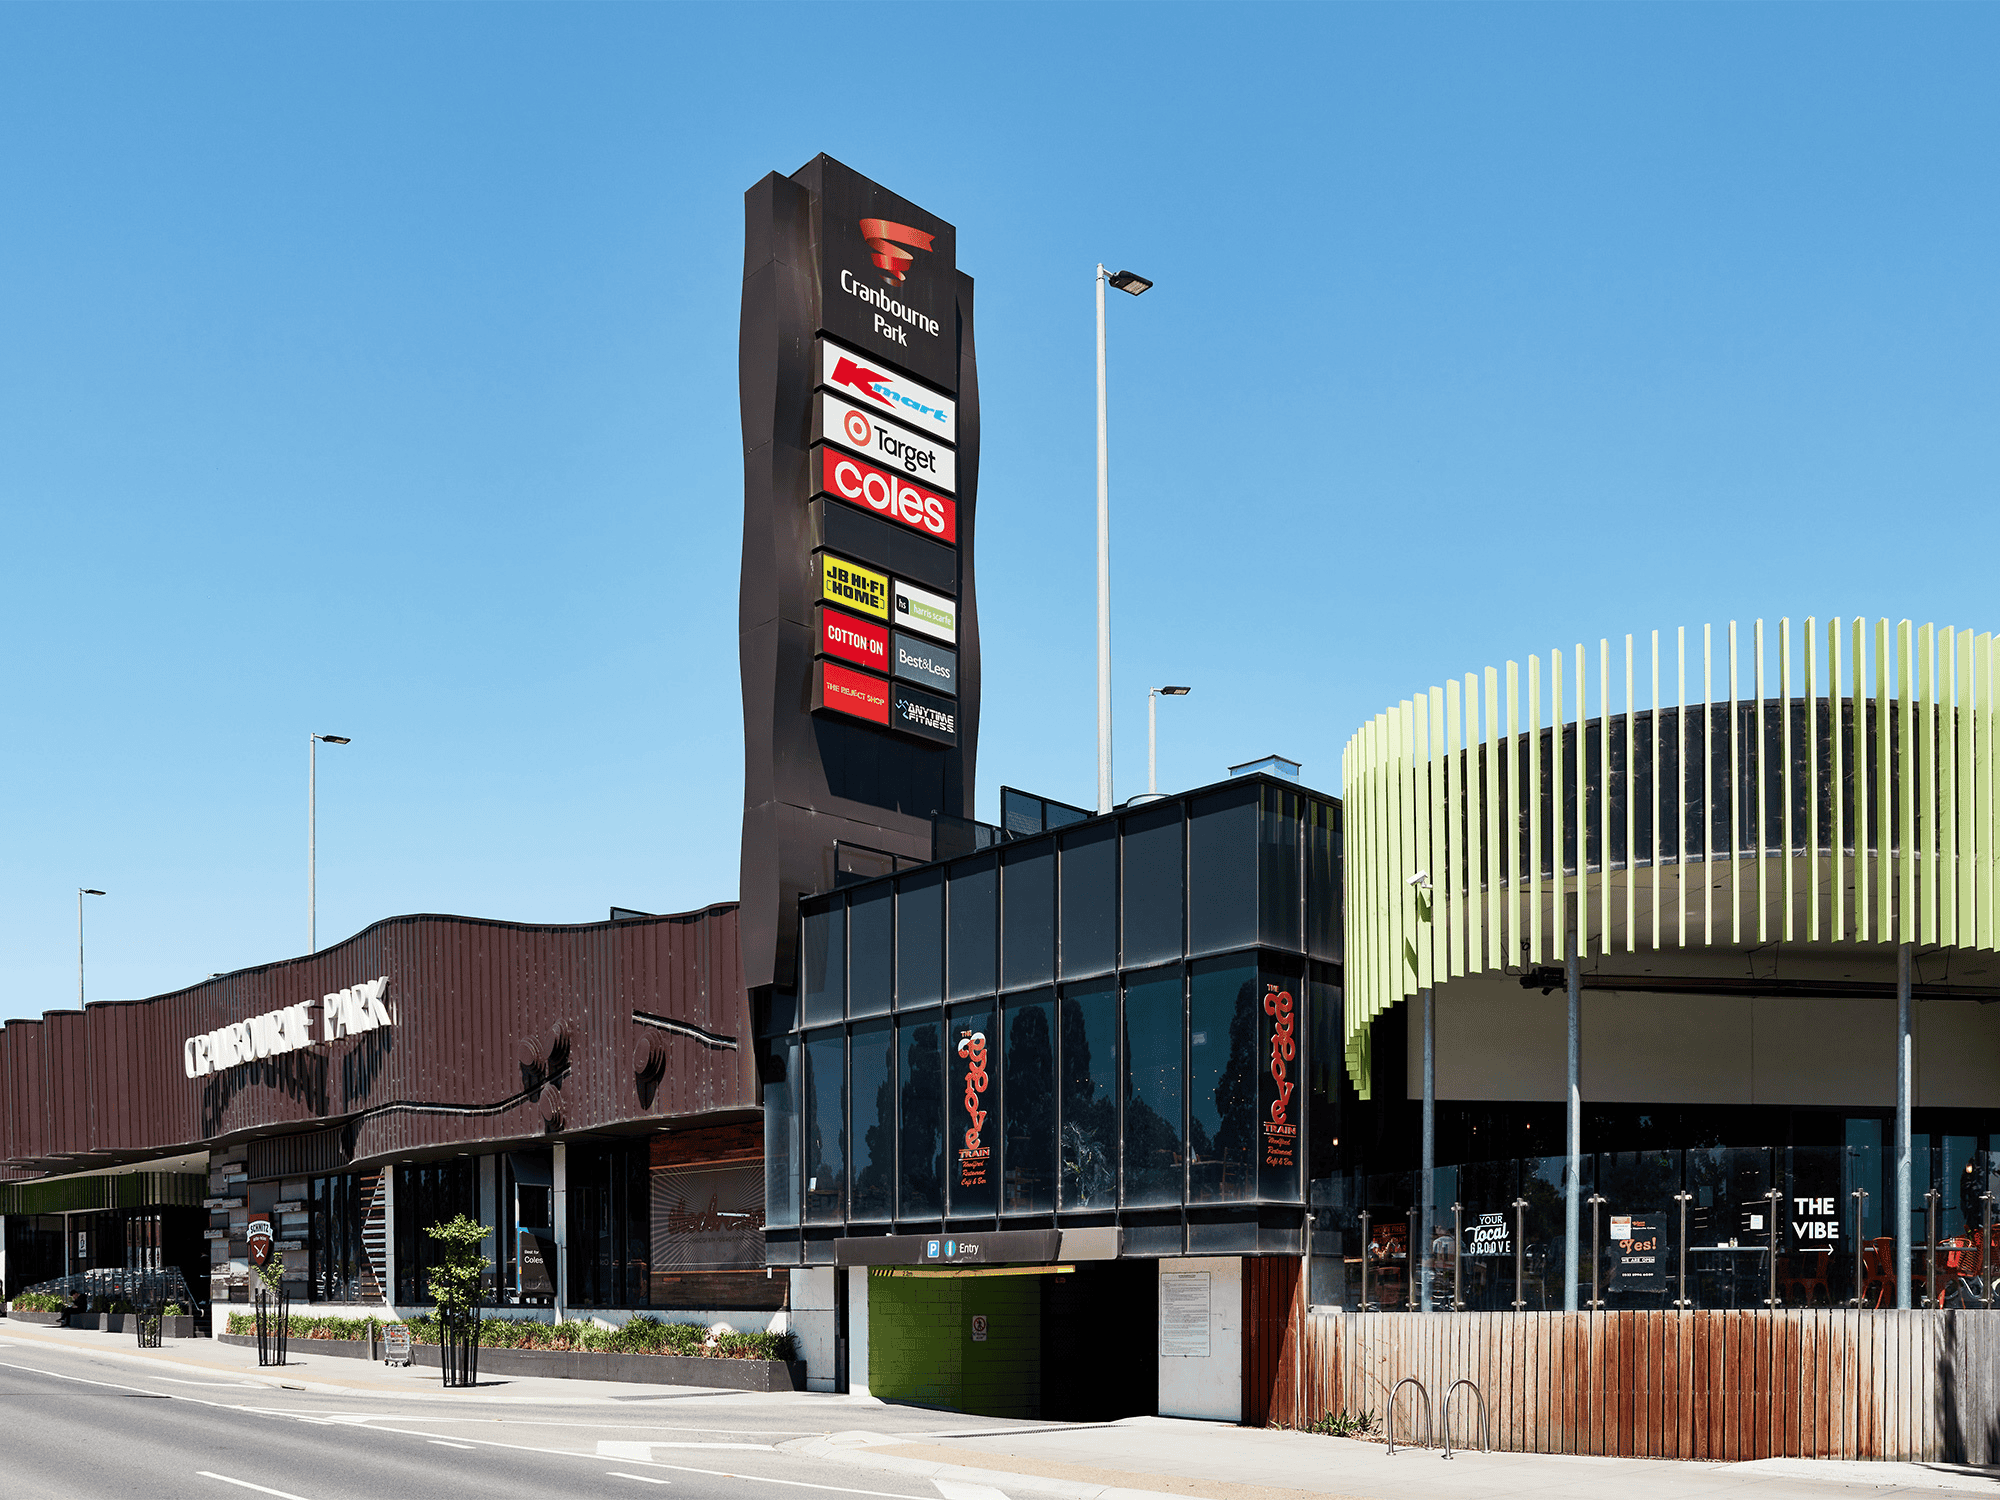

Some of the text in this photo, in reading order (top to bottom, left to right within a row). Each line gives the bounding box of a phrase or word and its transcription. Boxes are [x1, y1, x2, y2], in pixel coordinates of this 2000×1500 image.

[840, 269, 939, 337] Cranbourne
[874, 313, 907, 347] Park
[831, 356, 948, 423] Kmart
[874, 425, 936, 473] Target
[834, 460, 945, 533] coles
[827, 566, 848, 583] JB
[913, 604, 951, 626] harris scarfe
[899, 648, 951, 679] Best&Less
[826, 682, 885, 706] THE REJECT SHOP
[908, 703, 954, 724] ANYTIME
[909, 713, 955, 733] FITNESS
[1267, 984, 1280, 993] THE
[323, 975, 392, 1041] PARK
[960, 1030, 973, 1038] THE
[1263, 1123, 1297, 1135] TRAIN
[958, 1149, 990, 1159] TRAIN
[1793, 1197, 1835, 1215] THE
[1479, 1215, 1503, 1224] YOUR
[1791, 1222, 1839, 1239] VIBE
[959, 1243, 979, 1255] Entry
[1470, 1240, 1511, 1254] GROOVE
[1619, 1236, 1657, 1254] Yes!
[523, 1256, 544, 1265] Coles
